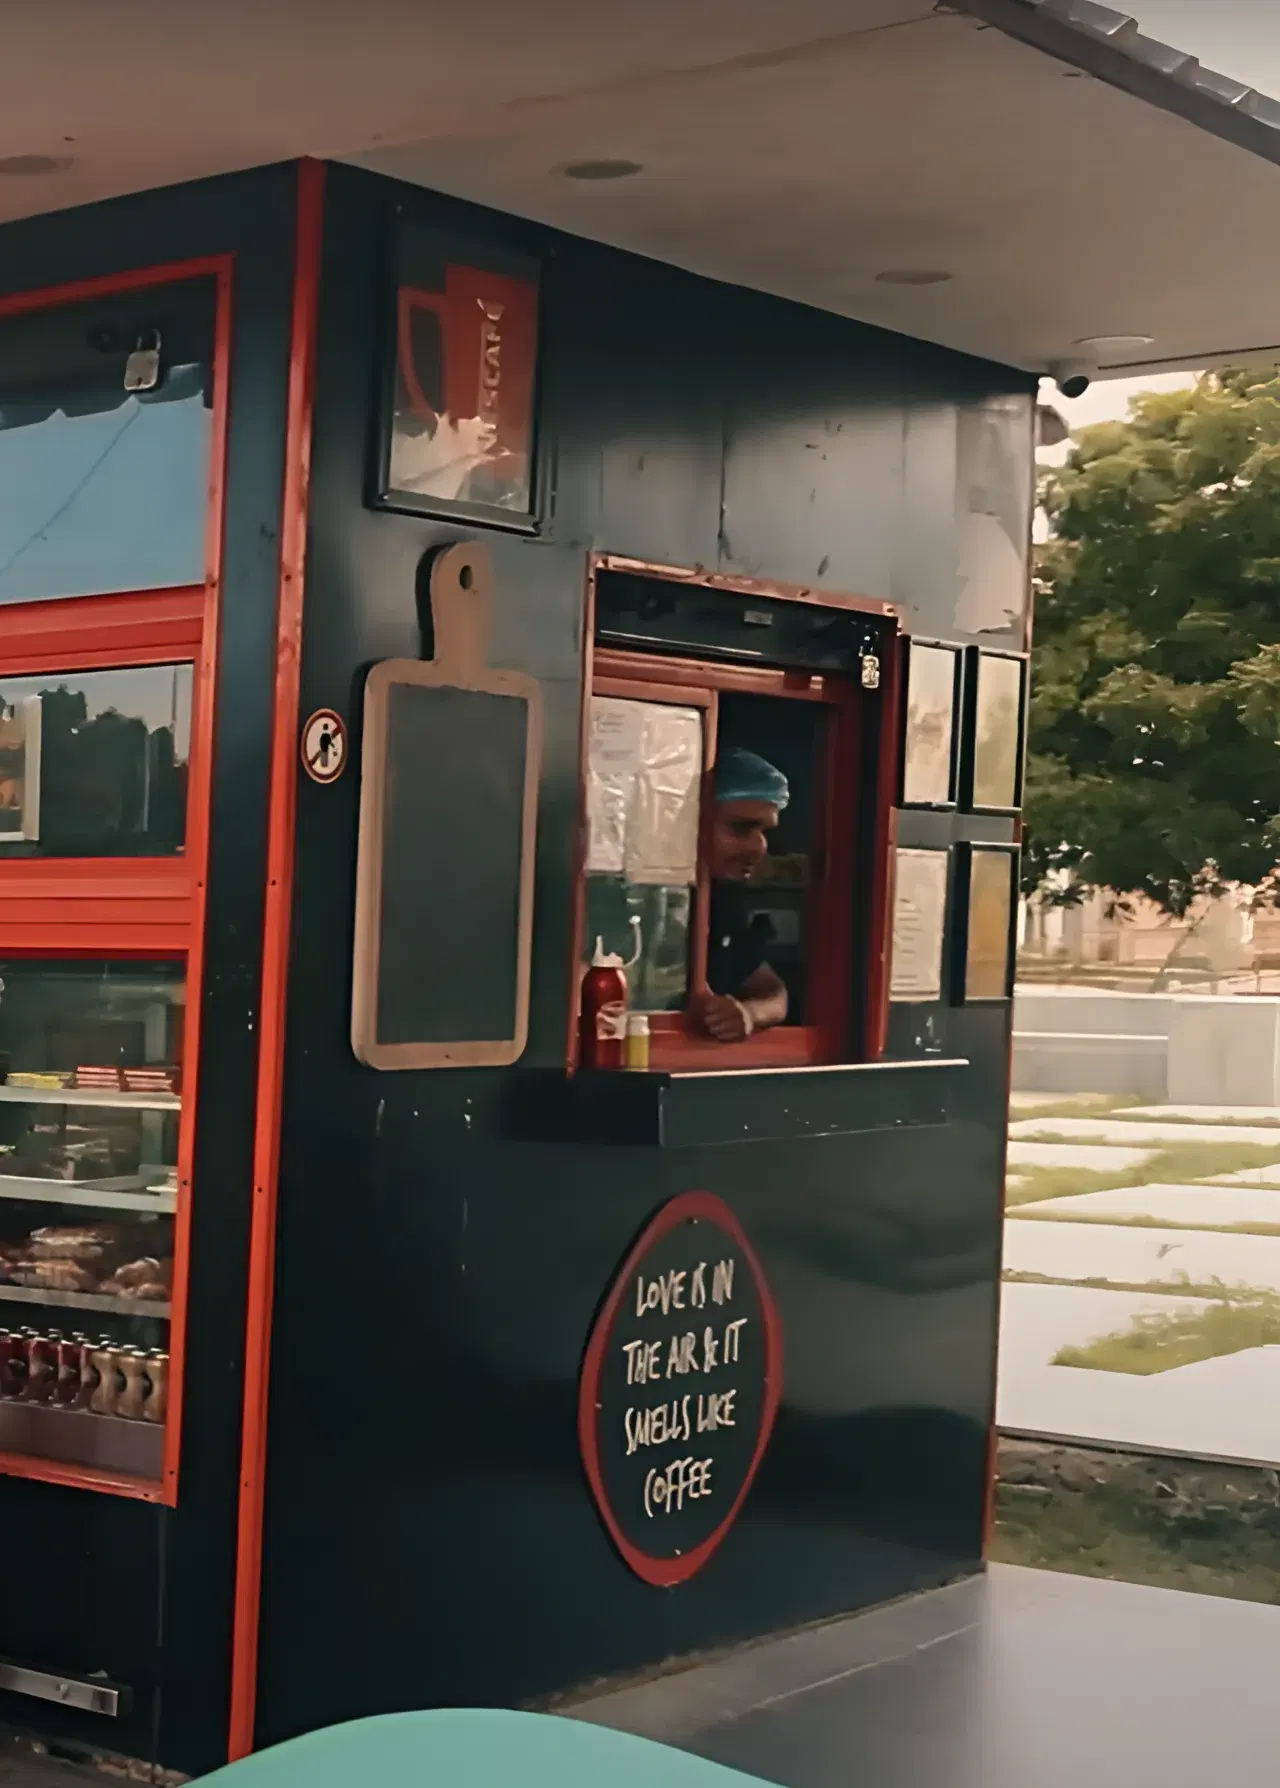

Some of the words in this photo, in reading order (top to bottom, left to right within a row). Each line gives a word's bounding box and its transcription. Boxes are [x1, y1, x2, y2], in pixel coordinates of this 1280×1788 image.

[636, 1269, 687, 1317] LOVE
[690, 1261, 708, 1309] IS
[711, 1258, 735, 1306] IN
[622, 1339, 662, 1385] THE
[665, 1331, 700, 1380] AIR
[703, 1326, 719, 1373] &
[723, 1317, 748, 1364] IT
[624, 1394, 691, 1456] SMELLS
[696, 1389, 737, 1433] LIKE
[644, 1456, 713, 1518] COFFEE
